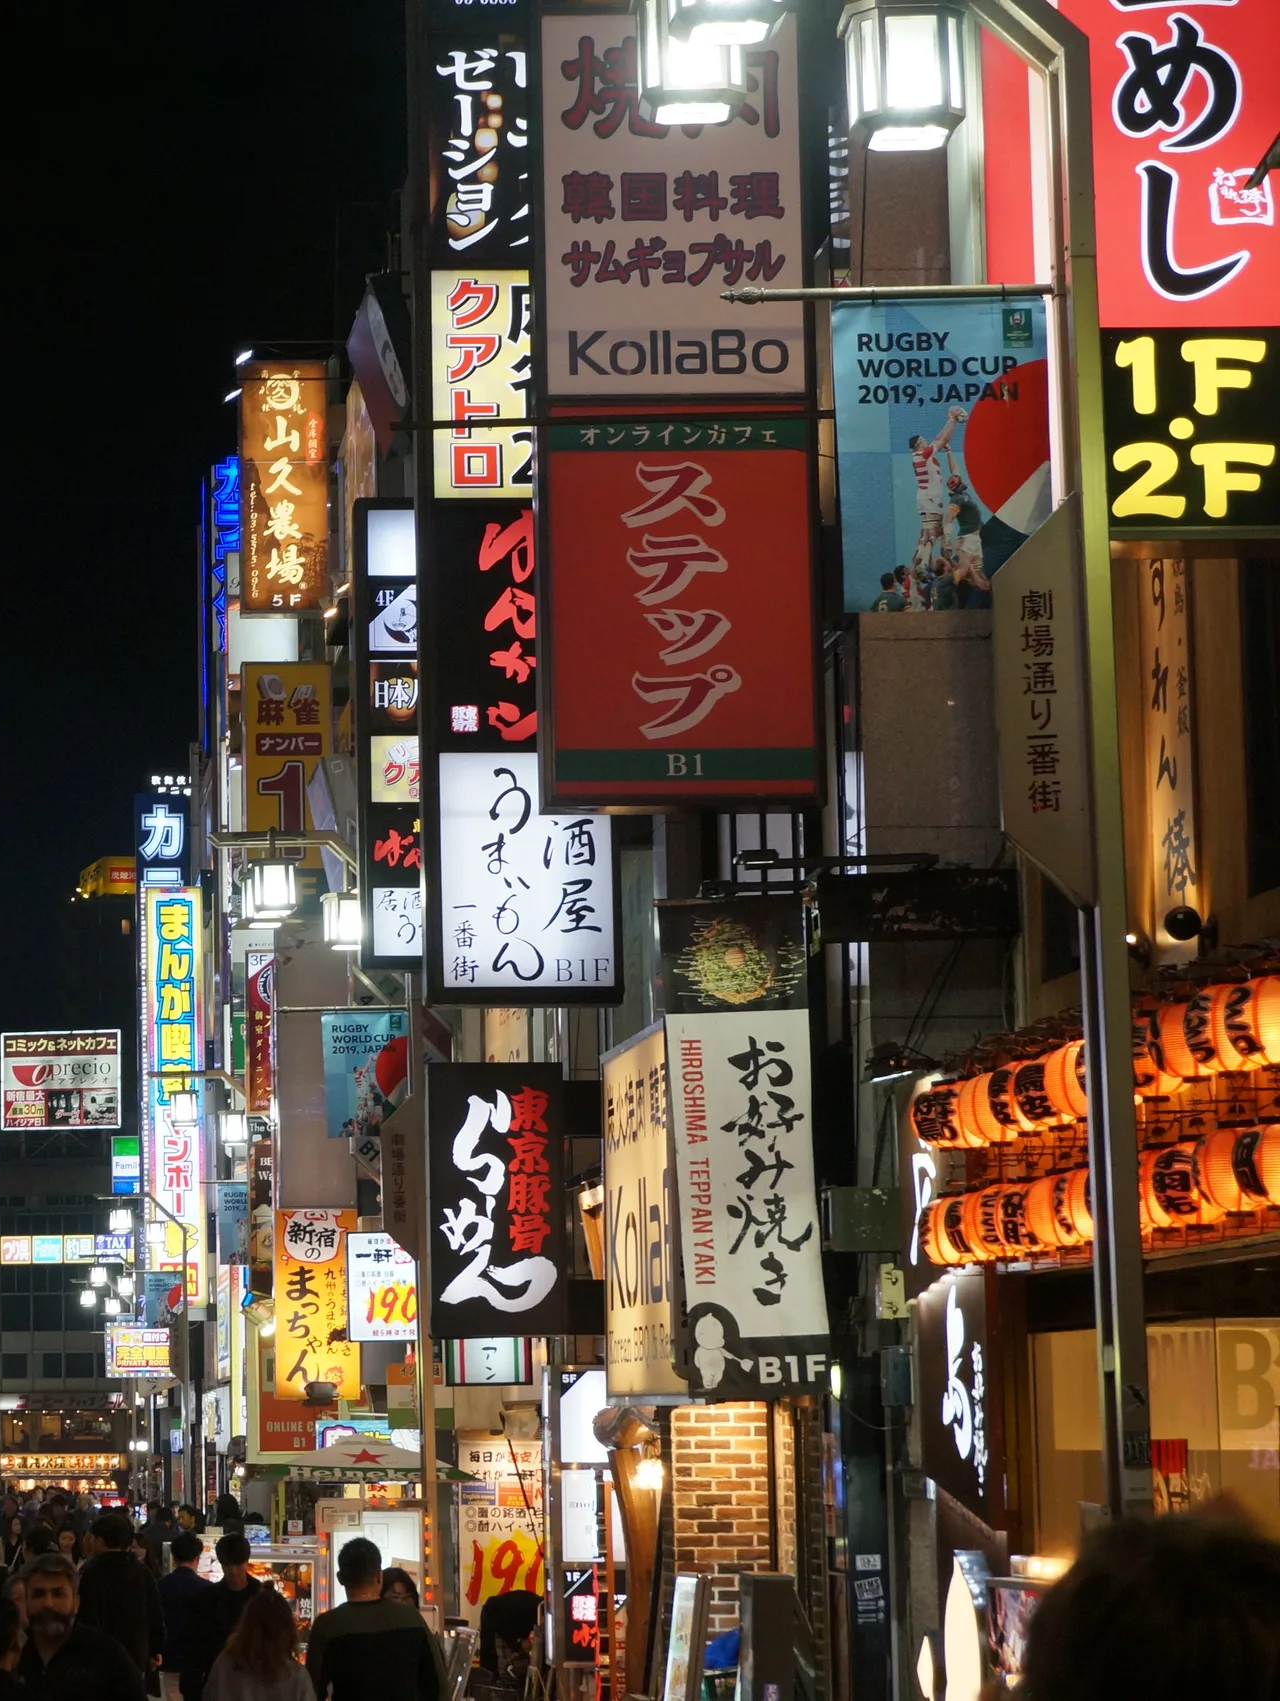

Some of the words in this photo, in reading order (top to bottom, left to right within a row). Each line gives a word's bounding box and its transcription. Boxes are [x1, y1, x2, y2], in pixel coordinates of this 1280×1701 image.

[435, 48, 498, 252] ゼーション
[561, 169, 786, 224] 韓国料理
[561, 233, 786, 287] サムギョプサル
[569, 329, 790, 376] KollaBo
[856, 331, 950, 352] RUGBY
[856, 356, 954, 378] WORLD
[960, 355, 1018, 377] CUP
[1114, 336, 1267, 416] 1F
[447, 278, 501, 488] クアトロ
[857, 383, 925, 406] 2019,
[929, 381, 1019, 403] JAPAN
[579, 423, 778, 447] オンラインカフェ
[1111, 442, 1276, 518] 2F
[263, 413, 306, 588] 山久農場
[272, 593, 302, 607] 5F
[375, 589, 394, 606] 4F
[621, 460, 742, 740] ステップ
[256, 699, 320, 726] 麻雀
[1020, 588, 1062, 813] 劇場通り一番街
[259, 736, 320, 752] ナンバー
[665, 752, 705, 778] B1
[256, 760, 306, 861] 1
[481, 767, 545, 982] うまいもん
[542, 818, 603, 934] 酒屋
[450, 904, 480, 984] 一番街
[249, 954, 268, 966] 3F
[555, 957, 610, 982] B1F
[331, 1023, 368, 1034] RUGBY
[331, 1034, 371, 1044] WORLD
[372, 1034, 397, 1044] CUP
[5, 1036, 117, 1053] コミック&ネットカフェ
[254, 1010, 266, 1097] 個室ダイニング
[331, 1044, 360, 1055] 2019,
[360, 1043, 397, 1055] JAPAN
[58, 1077, 109, 1085] アプレシオ
[679, 1038, 708, 1146] HIROSHIMA
[6, 1090, 45, 1102] 新宿最大
[6, 1117, 46, 1127] ハイジアB1
[507, 1085, 551, 1255] 東京豚骨
[720, 1035, 813, 1307] お好み焼き
[105, 1236, 126, 1249] TAX
[287, 1220, 338, 1249] 新宿
[304, 1247, 322, 1260] の
[285, 1265, 323, 1386] まっちゃん
[116, 1359, 147, 1367] PRIVATE
[758, 1353, 827, 1384] B1F
[561, 1374, 577, 1383] 5F
[266, 1420, 304, 1433] ONLINE
[292, 1436, 306, 1448] B1
[565, 1571, 581, 1582] 1F
